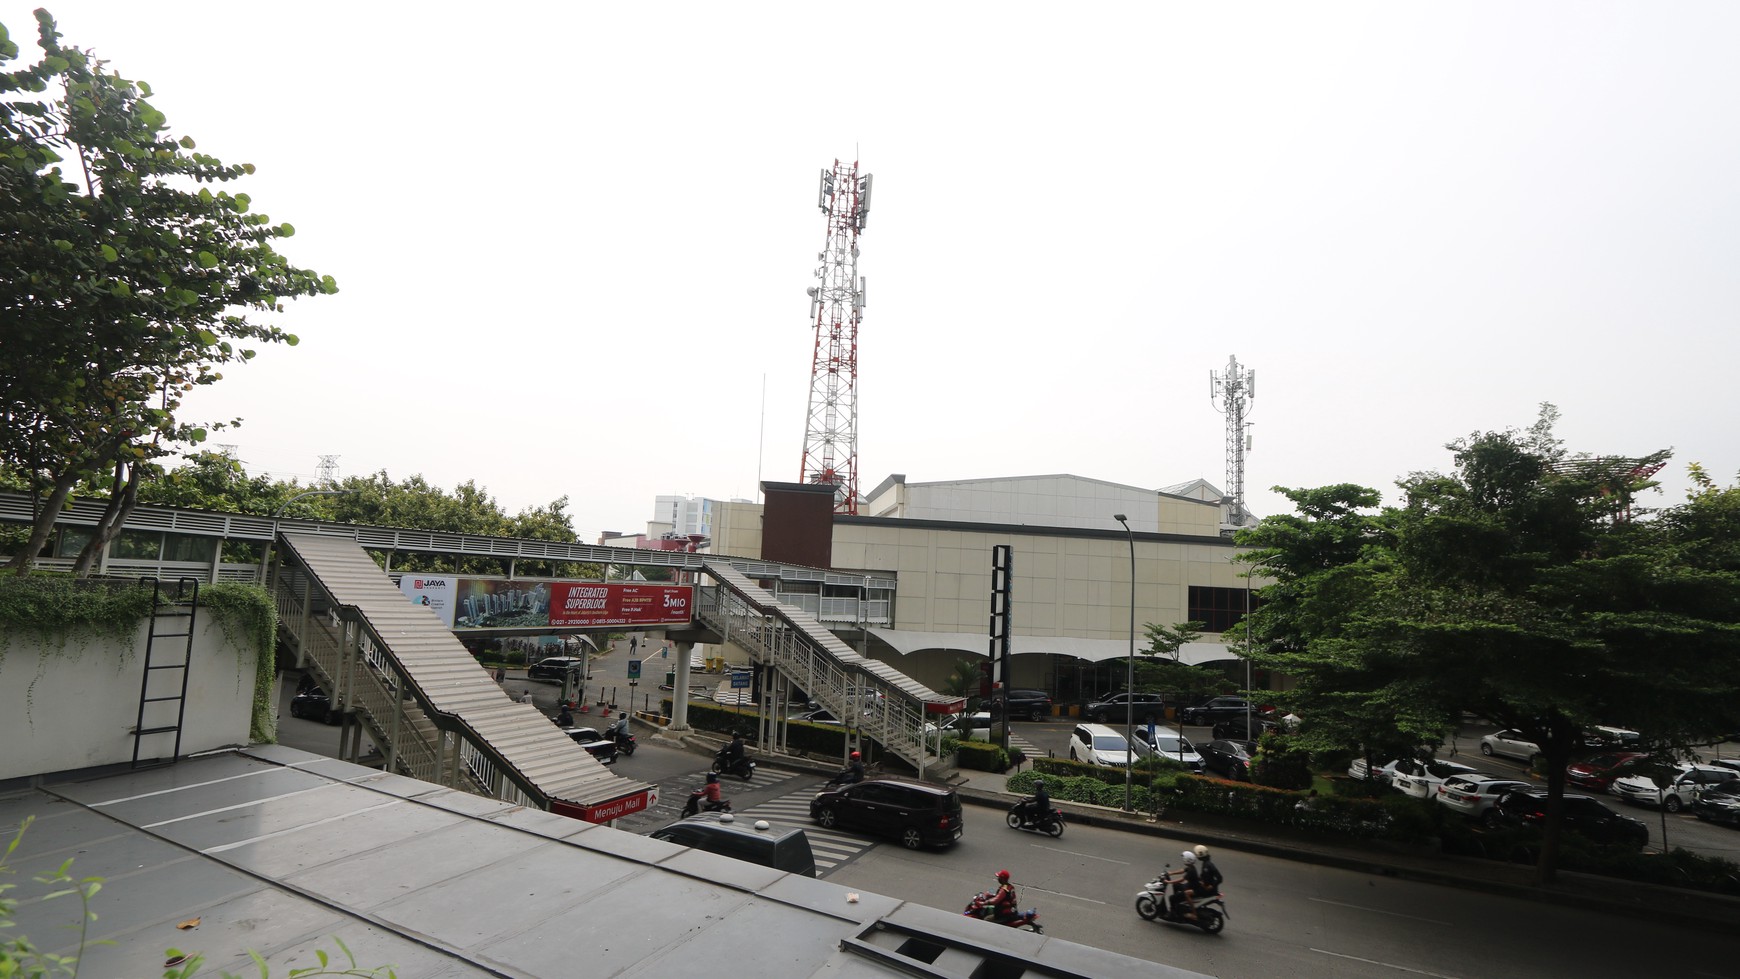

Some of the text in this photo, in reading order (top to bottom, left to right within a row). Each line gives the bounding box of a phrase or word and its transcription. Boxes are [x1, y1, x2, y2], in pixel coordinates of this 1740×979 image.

[568, 587, 608, 598] INTEGRATED
[565, 599, 607, 609] SUPERBLOCK
[595, 798, 640, 820] Menuju Mall
